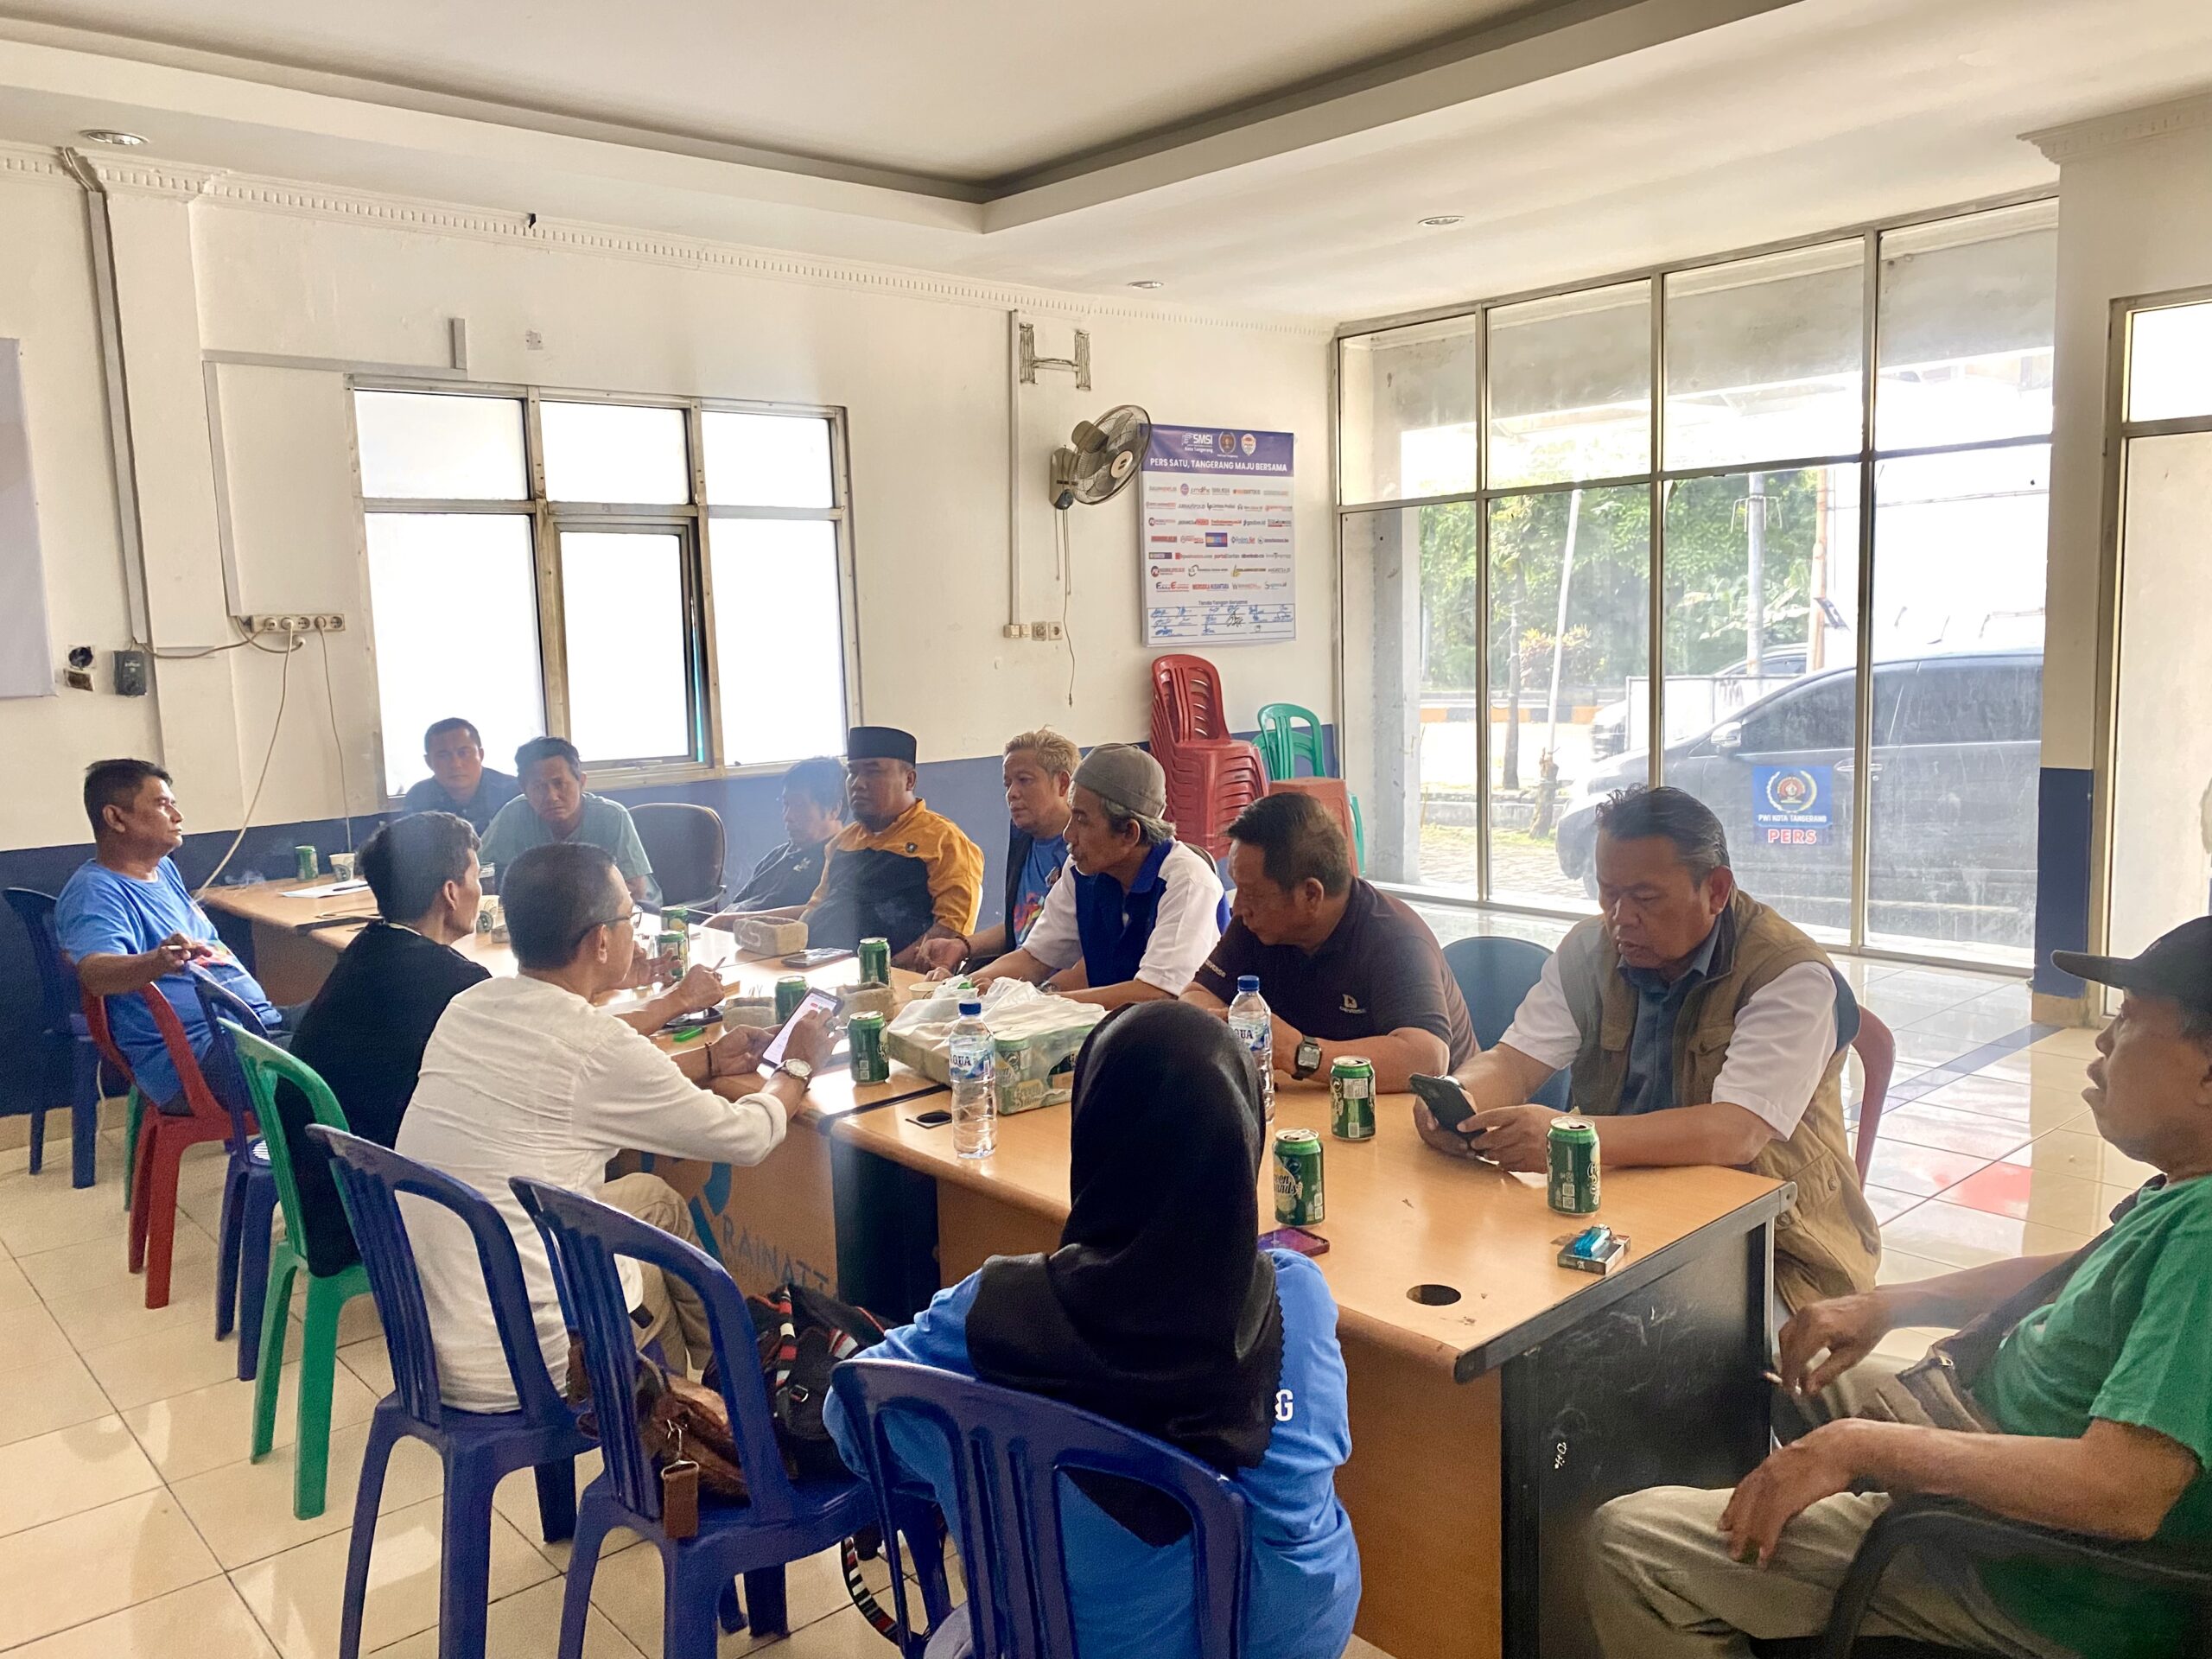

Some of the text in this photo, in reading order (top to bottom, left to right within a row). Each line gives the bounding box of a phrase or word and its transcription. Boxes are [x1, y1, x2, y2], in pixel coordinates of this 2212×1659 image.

[1193, 434, 1213, 444] SMSI
[1150, 458, 1287, 472] PERS SATU, TANGERANG MAJU BERSAMA
[1768, 830, 1817, 844] PERS
